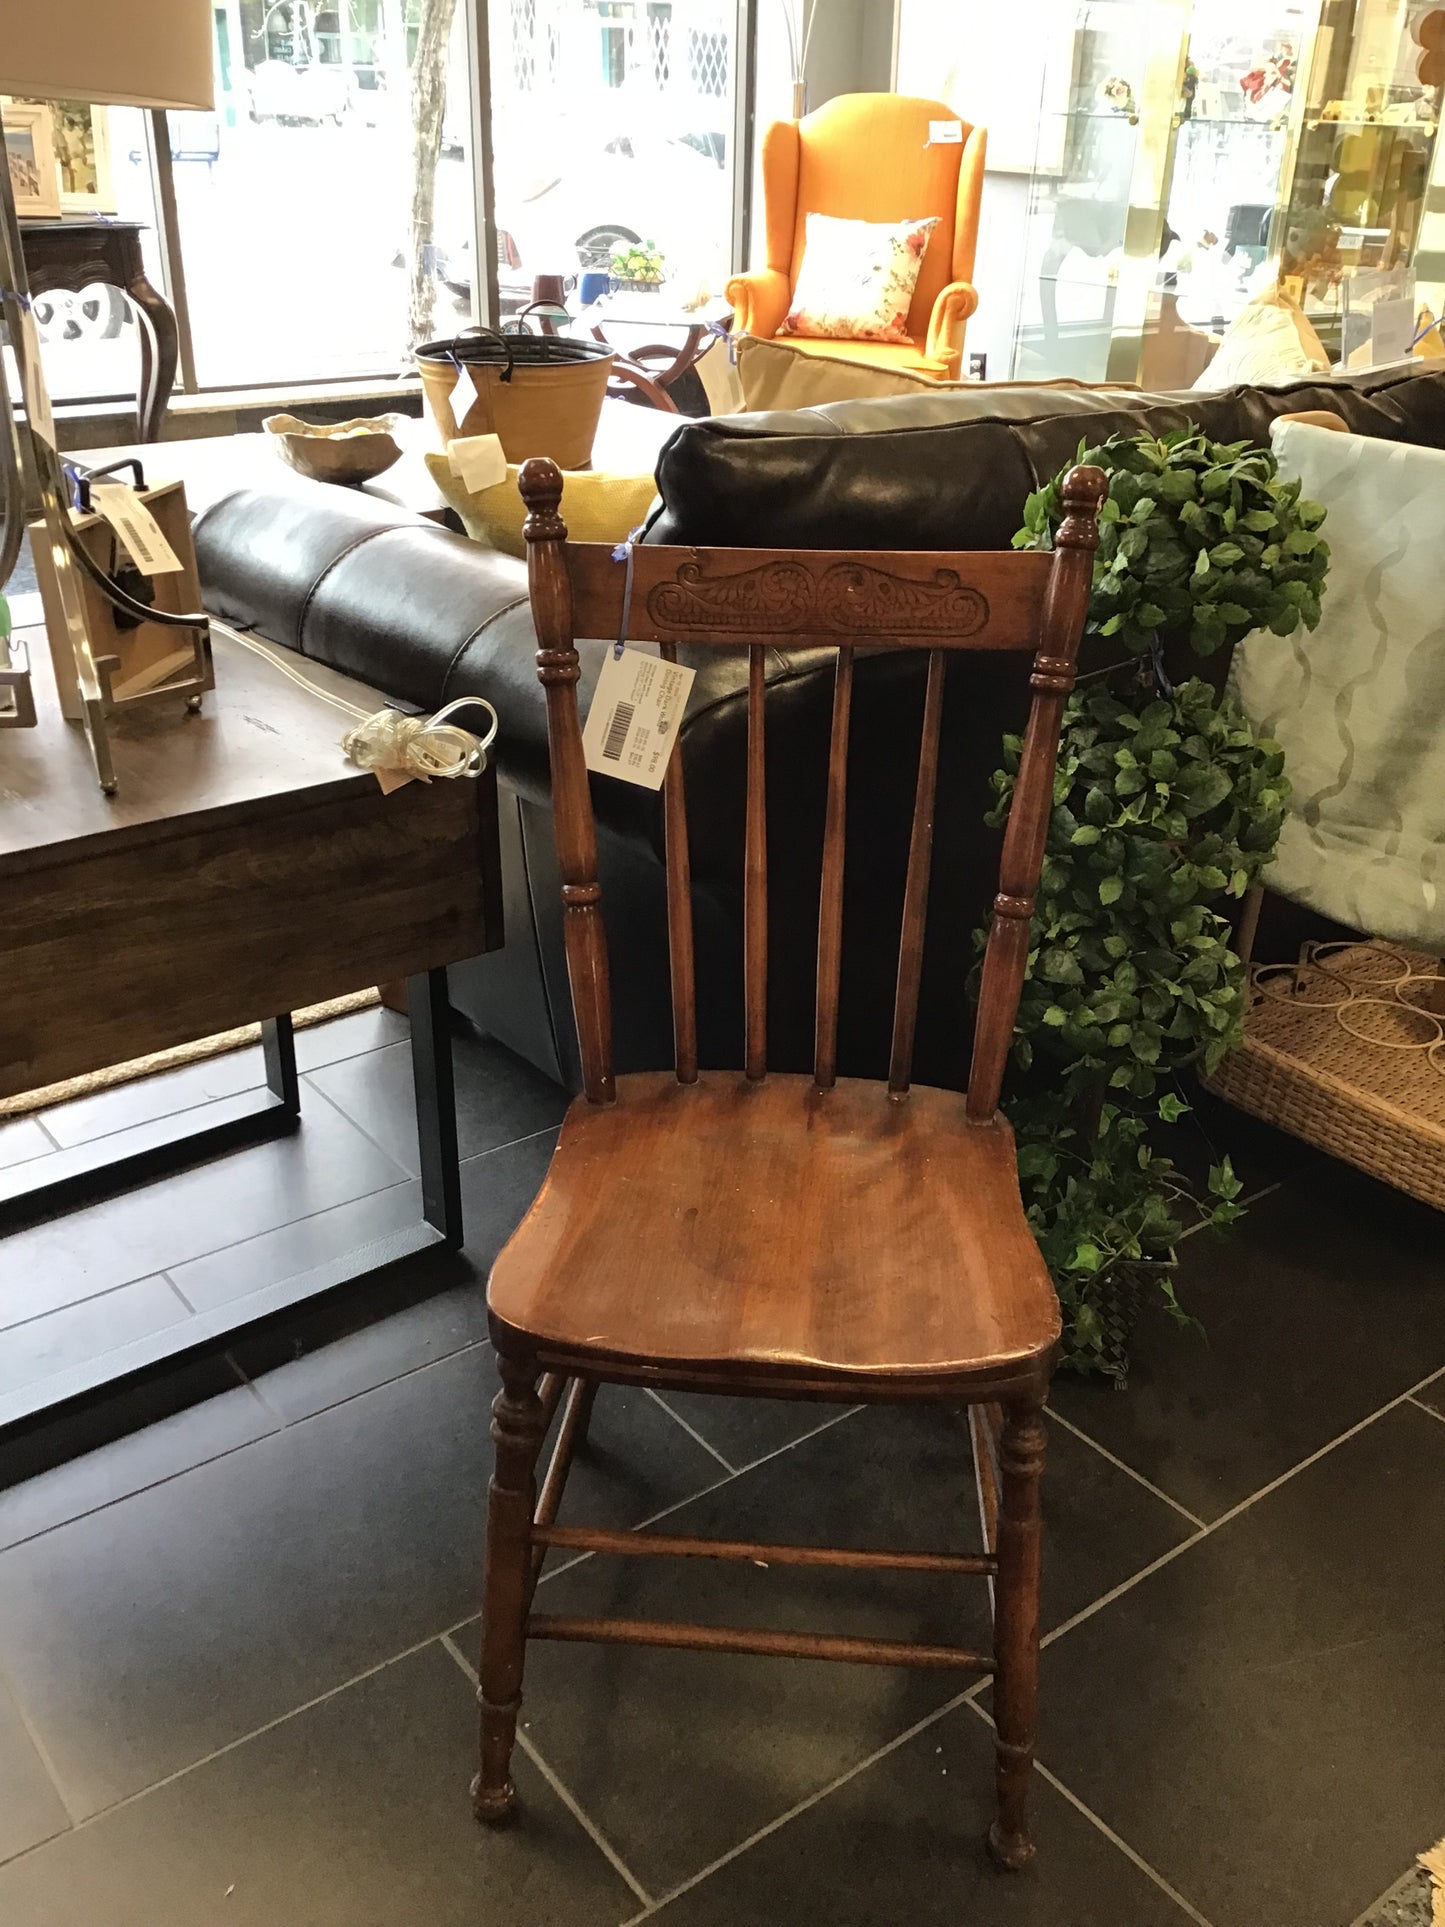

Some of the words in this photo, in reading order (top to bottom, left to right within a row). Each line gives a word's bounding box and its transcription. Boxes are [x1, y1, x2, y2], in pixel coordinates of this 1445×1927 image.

[659, 668, 671, 689] Dining
[666, 670, 678, 694] Vintage
[655, 690, 664, 707] Chair
[661, 694, 671, 710] Dark
